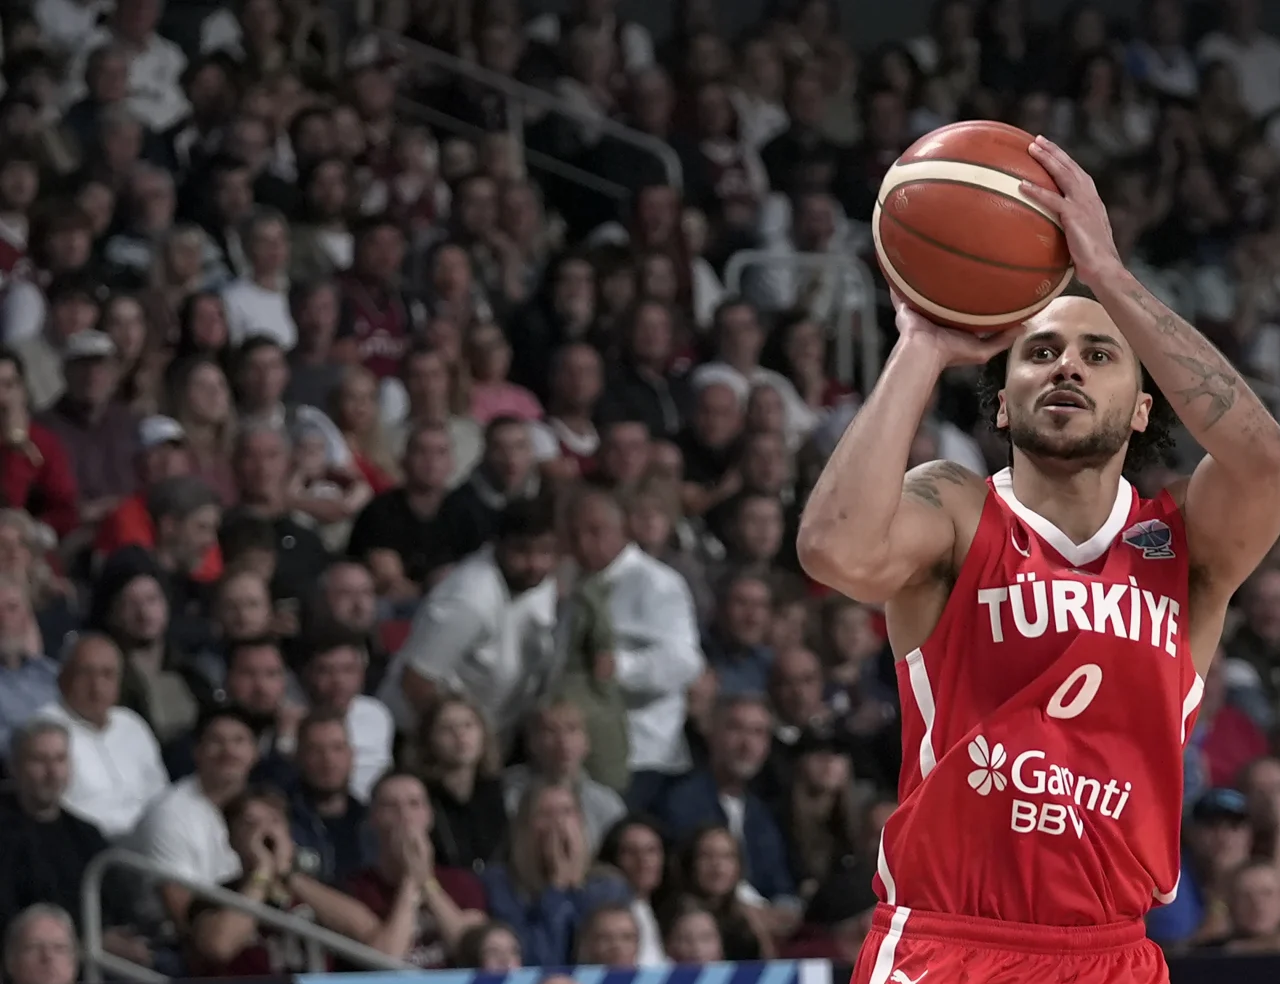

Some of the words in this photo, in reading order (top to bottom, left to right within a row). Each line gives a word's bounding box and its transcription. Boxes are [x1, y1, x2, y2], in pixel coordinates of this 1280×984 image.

[978, 572, 1180, 658] TÜRKİYE
[1047, 664, 1102, 719] 0
[1011, 799, 1084, 839] BBV
